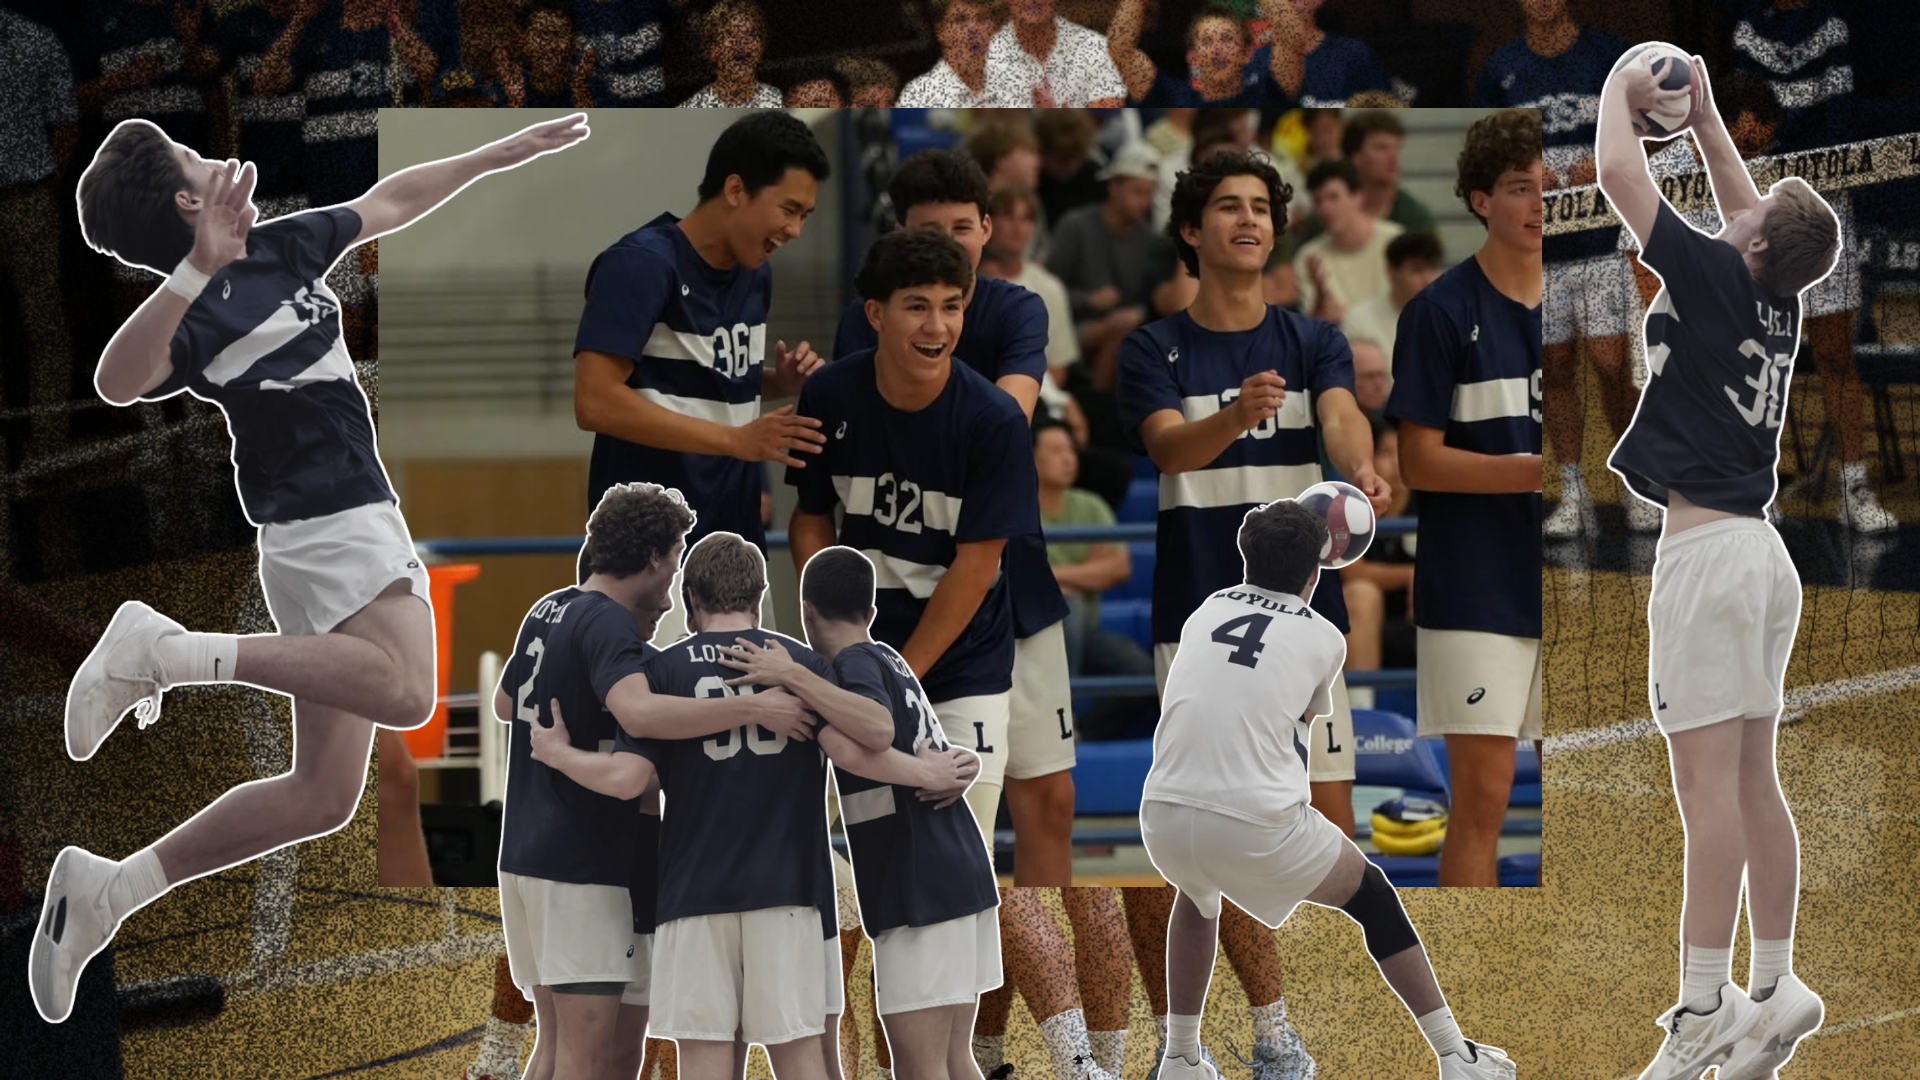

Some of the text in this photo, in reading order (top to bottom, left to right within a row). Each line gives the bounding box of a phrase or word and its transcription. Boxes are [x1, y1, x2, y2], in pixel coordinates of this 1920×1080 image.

[1661, 171, 1713, 202] OYO
[1775, 145, 1874, 181] LOYOLA
[712, 322, 750, 379] 36
[874, 472, 923, 535] 32
[1211, 612, 1274, 669] 4
[1656, 683, 1668, 710] L
[973, 721, 994, 753] L
[1057, 708, 1073, 740] L
[1326, 722, 1342, 753] L
[1354, 734, 1414, 755] College
